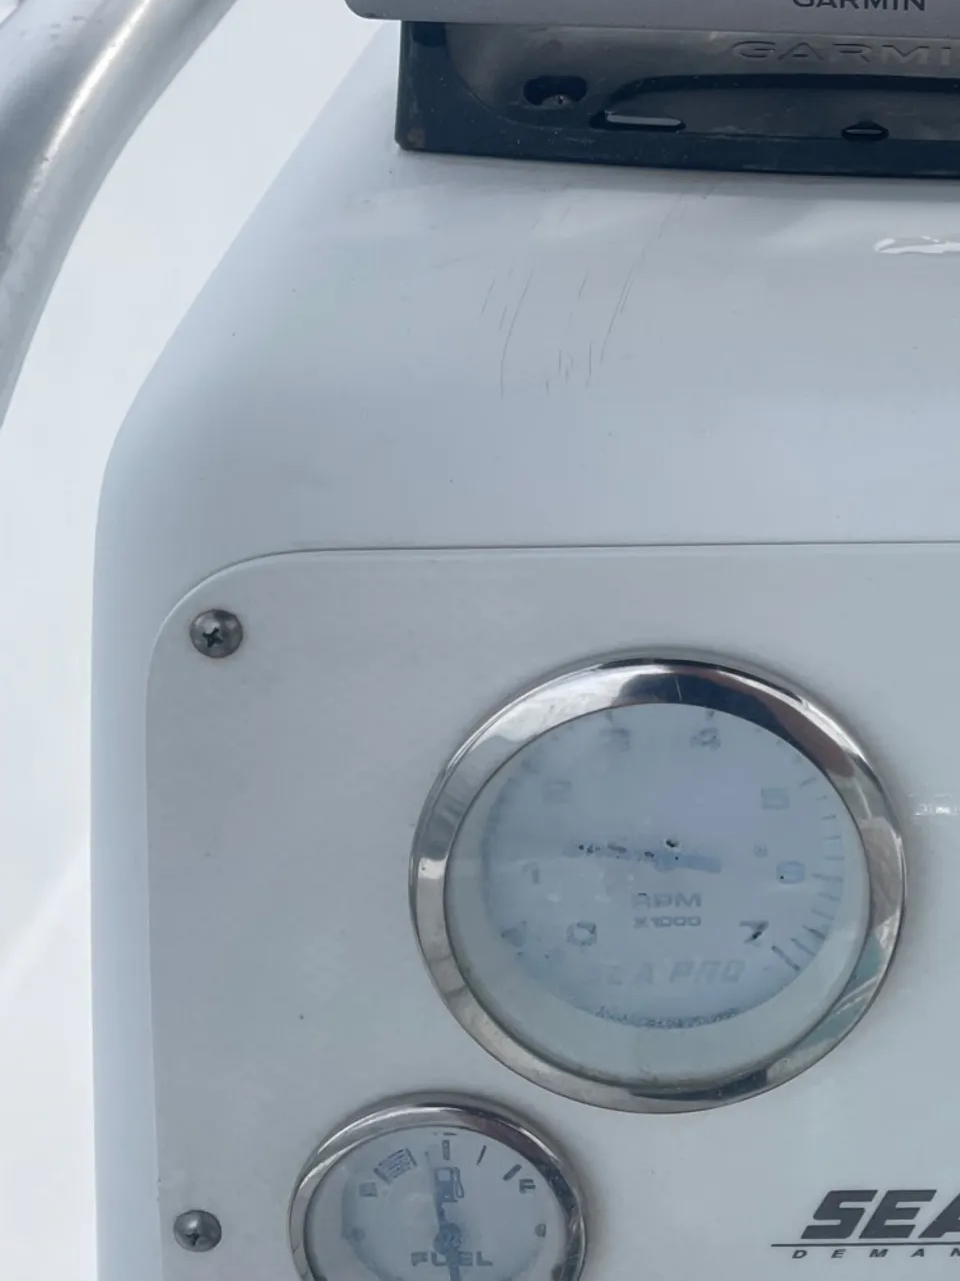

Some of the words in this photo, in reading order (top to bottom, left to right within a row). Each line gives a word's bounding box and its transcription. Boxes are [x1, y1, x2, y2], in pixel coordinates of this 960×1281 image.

[632, 892, 702, 908] RPM
[738, 920, 770, 946] 7
[410, 1250, 494, 1268] FUEL
